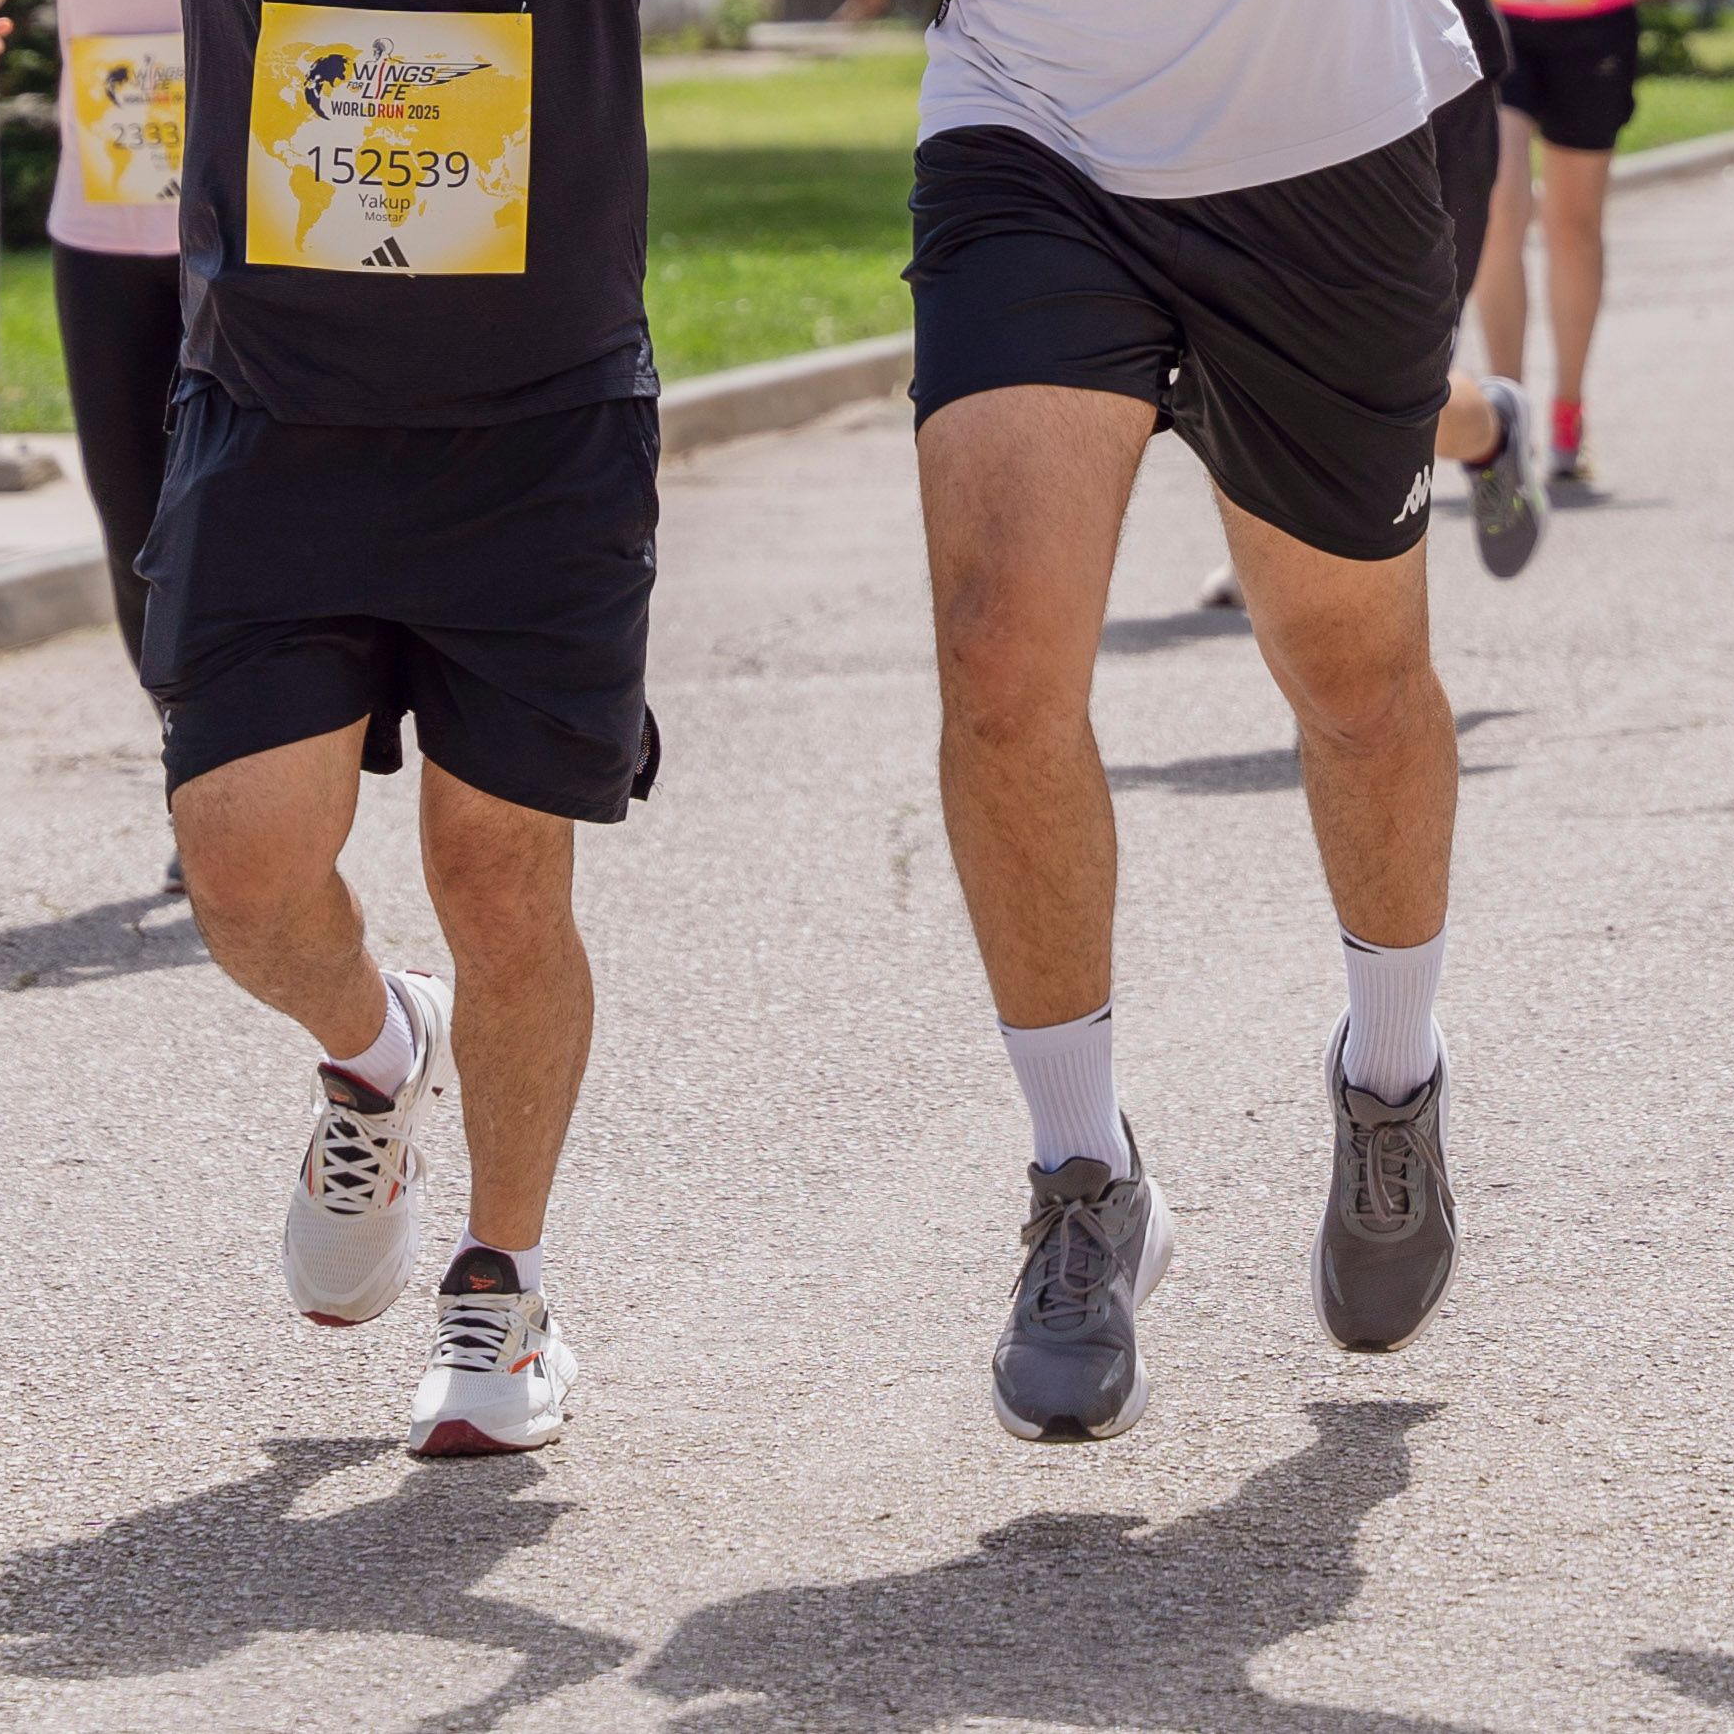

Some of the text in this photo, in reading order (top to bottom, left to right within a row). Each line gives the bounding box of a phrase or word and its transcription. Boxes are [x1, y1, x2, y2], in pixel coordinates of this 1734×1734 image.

[353, 60, 436, 83] WINGS
[362, 83, 410, 101] LIFE
[408, 105, 439, 119] 2025
[307, 146, 470, 188] 152539
[358, 194, 411, 213] Yakup
[365, 212, 404, 222] Mostar
